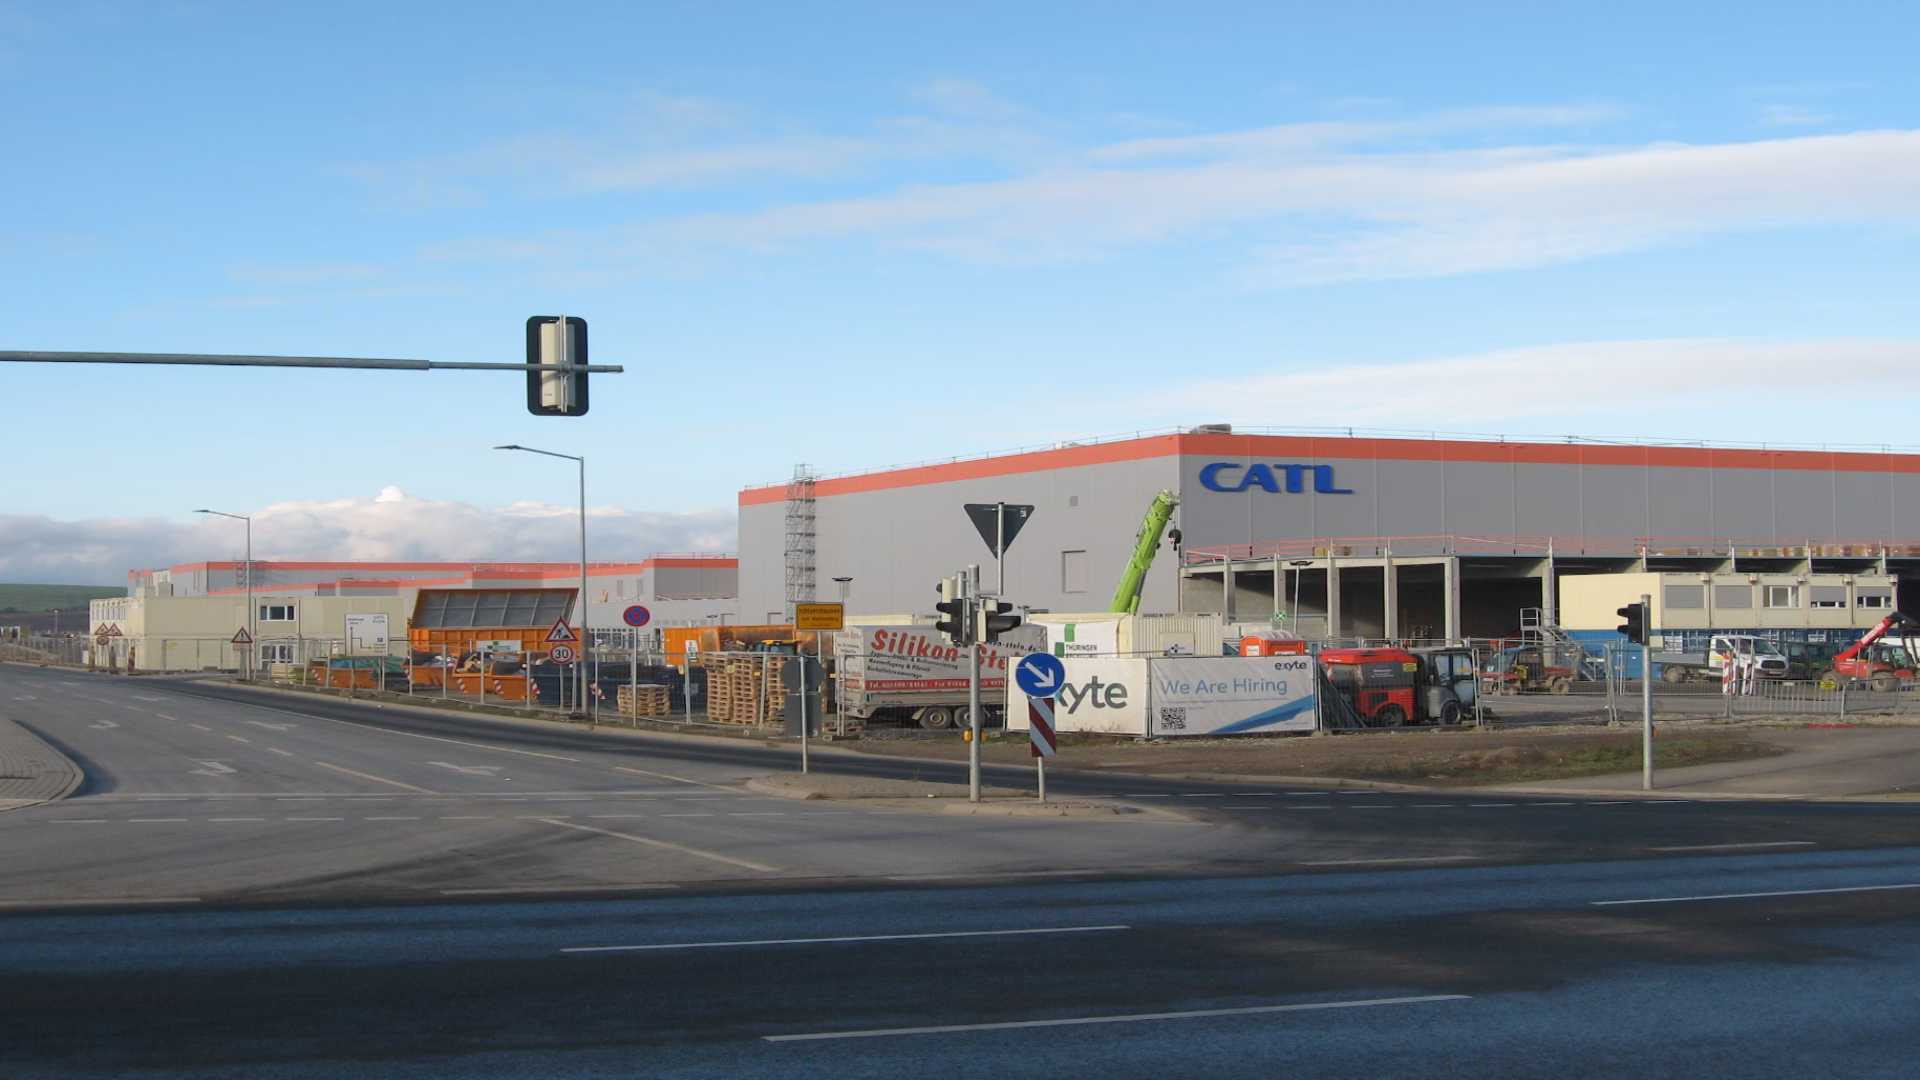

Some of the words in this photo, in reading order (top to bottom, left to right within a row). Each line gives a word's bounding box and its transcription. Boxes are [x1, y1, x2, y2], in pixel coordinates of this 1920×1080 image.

[1199, 463, 1354, 494] CATL
[554, 648, 569, 659] 30
[1055, 675, 1128, 714] xyte
[1160, 679, 1190, 695] We
[1195, 679, 1228, 695] Are
[1233, 677, 1288, 696] Hiring
